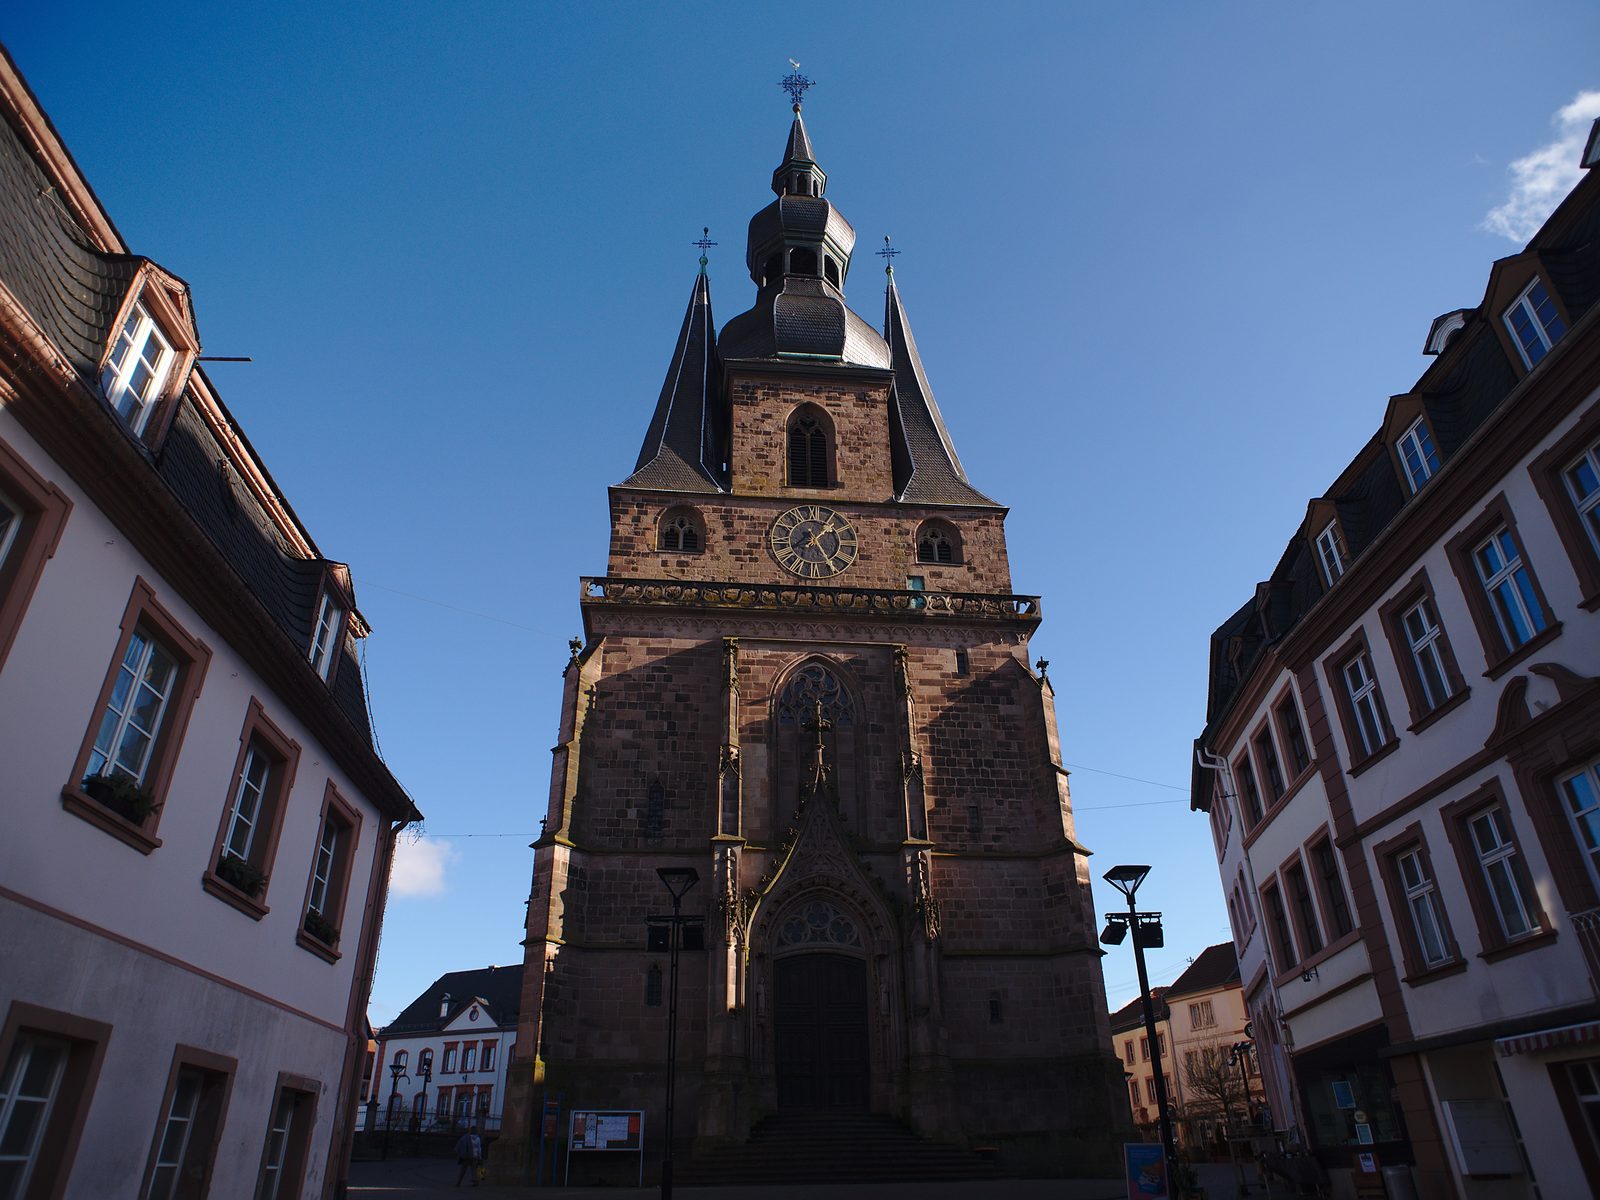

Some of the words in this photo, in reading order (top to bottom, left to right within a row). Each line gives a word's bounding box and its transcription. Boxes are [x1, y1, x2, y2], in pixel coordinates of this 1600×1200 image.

[788, 507, 805, 523] XI
[808, 505, 820, 521] XII
[775, 519, 794, 531] X
[835, 523, 851, 533] II
[772, 536, 790, 544] IX
[840, 539, 857, 547] III
[774, 547, 794, 563] VIII
[789, 558, 804, 574] VII
